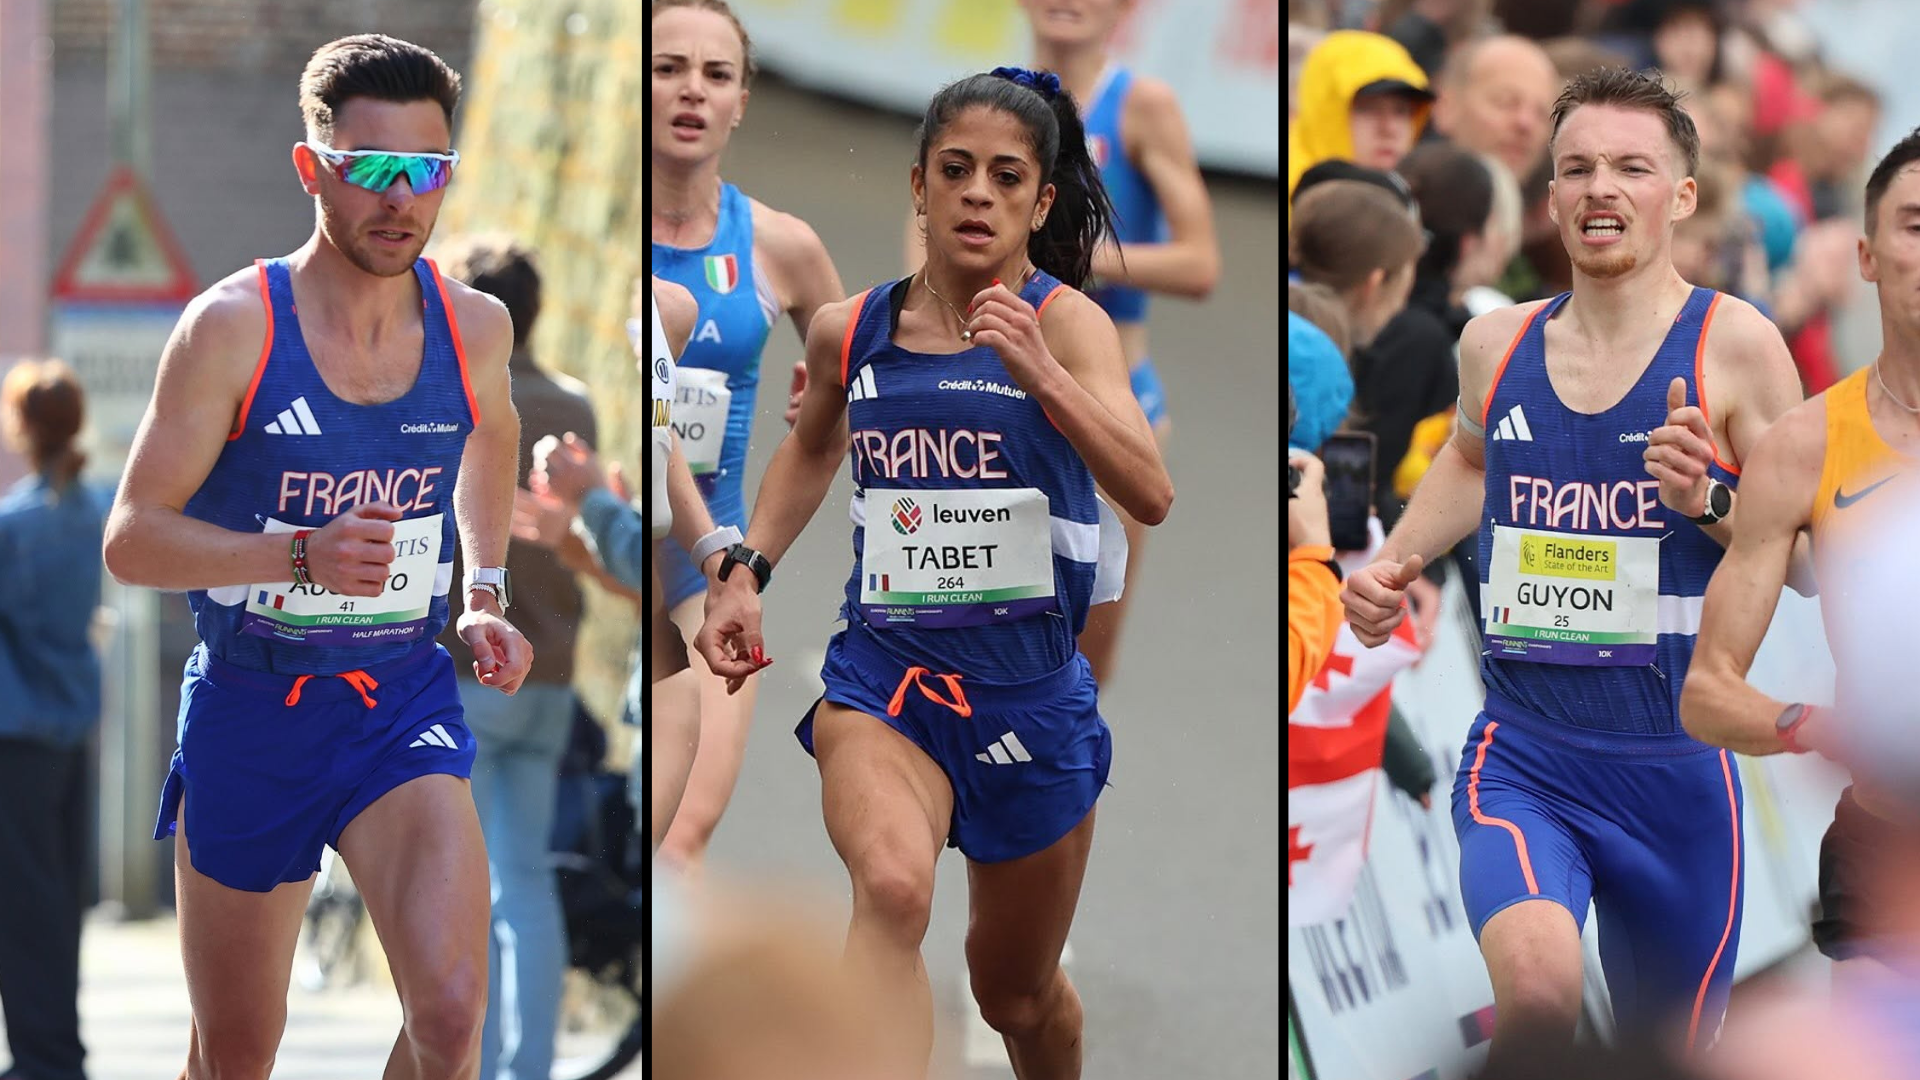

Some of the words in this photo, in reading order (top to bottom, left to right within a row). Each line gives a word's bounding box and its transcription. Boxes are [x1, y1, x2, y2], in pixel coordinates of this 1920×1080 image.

[938, 380, 972, 391] Crédit
[985, 382, 1027, 400] Mutuel
[400, 423, 428, 434] Crédit
[1619, 432, 1645, 443] Crédit
[851, 428, 1008, 481] FRANCE
[277, 466, 443, 516] FRANCE
[1510, 475, 1665, 530] FRANCE
[933, 503, 1011, 523] leuven
[901, 544, 998, 569] TABET
[1545, 543, 1609, 562] Flanders
[1544, 560, 1565, 570] State
[1566, 561, 1576, 571] of
[1578, 563, 1592, 573] the
[1594, 564, 1609, 573] Art
[937, 576, 965, 589] 264
[926, 595, 949, 603] RUN
[950, 593, 983, 603] CLEAN
[1517, 582, 1613, 612] GUYON
[339, 601, 355, 612] 41
[994, 607, 1008, 615] 10K
[320, 616, 342, 624] RUN
[342, 616, 374, 624] CLEAN
[1554, 614, 1570, 627] 25
[352, 630, 374, 639] HALF
[374, 626, 414, 638] MARATHON
[1538, 630, 1559, 639] RUN
[1559, 632, 1590, 642] CLEAN
[1598, 650, 1612, 658] 10K
